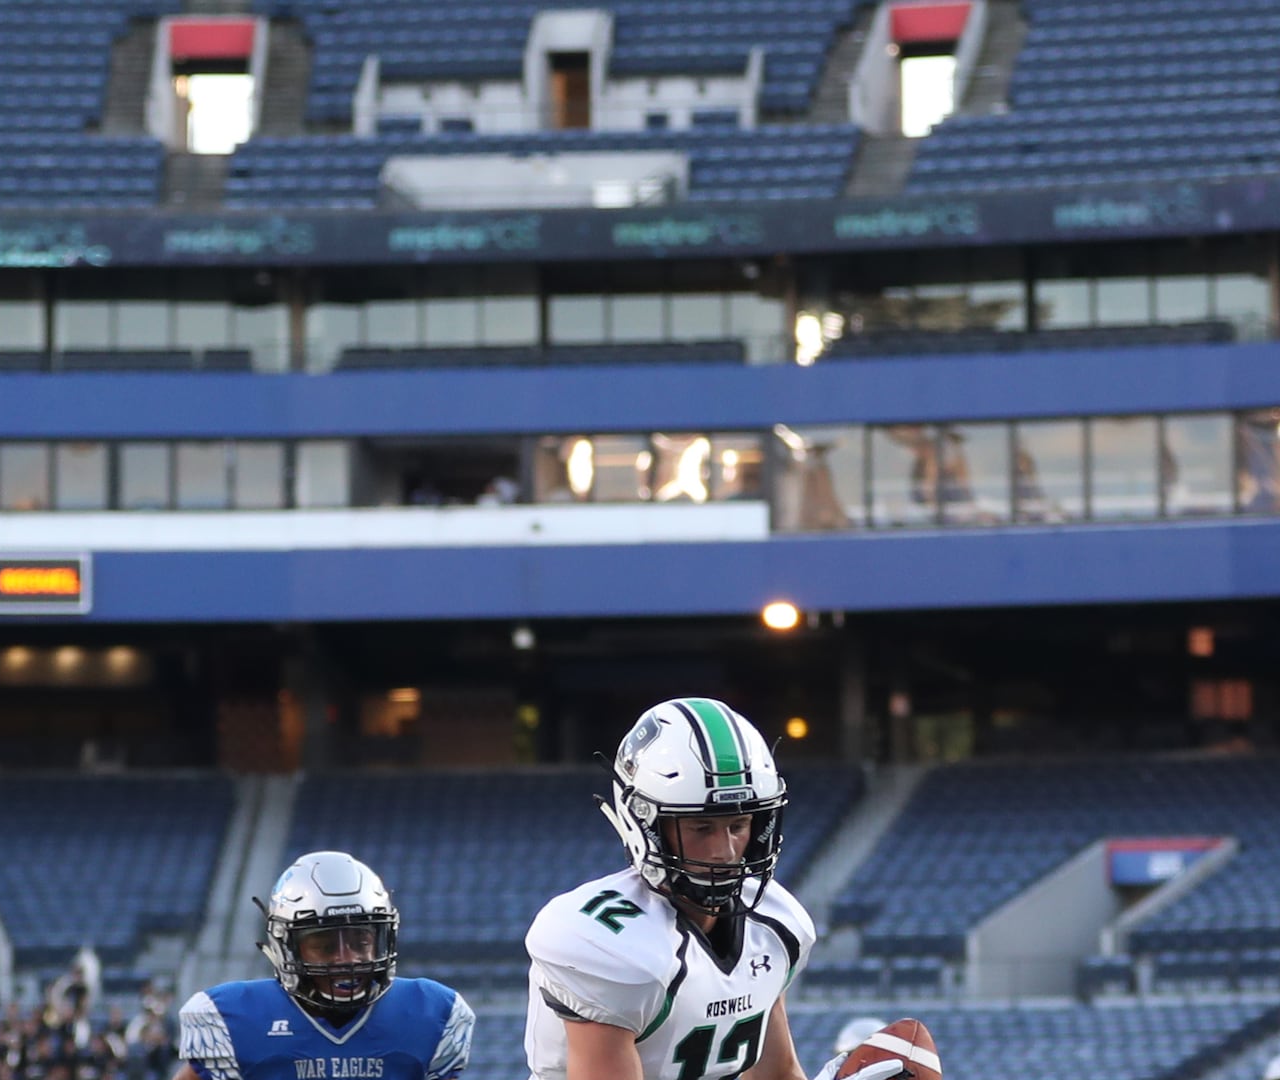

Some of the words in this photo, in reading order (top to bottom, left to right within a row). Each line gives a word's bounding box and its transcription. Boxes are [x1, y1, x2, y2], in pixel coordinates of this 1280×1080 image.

[327, 905, 362, 917] Riddell
[579, 890, 648, 935] 12
[706, 994, 753, 1018] ROSWELL
[294, 1058, 326, 1080] WAR
[330, 1057, 384, 1078] EAGLES
